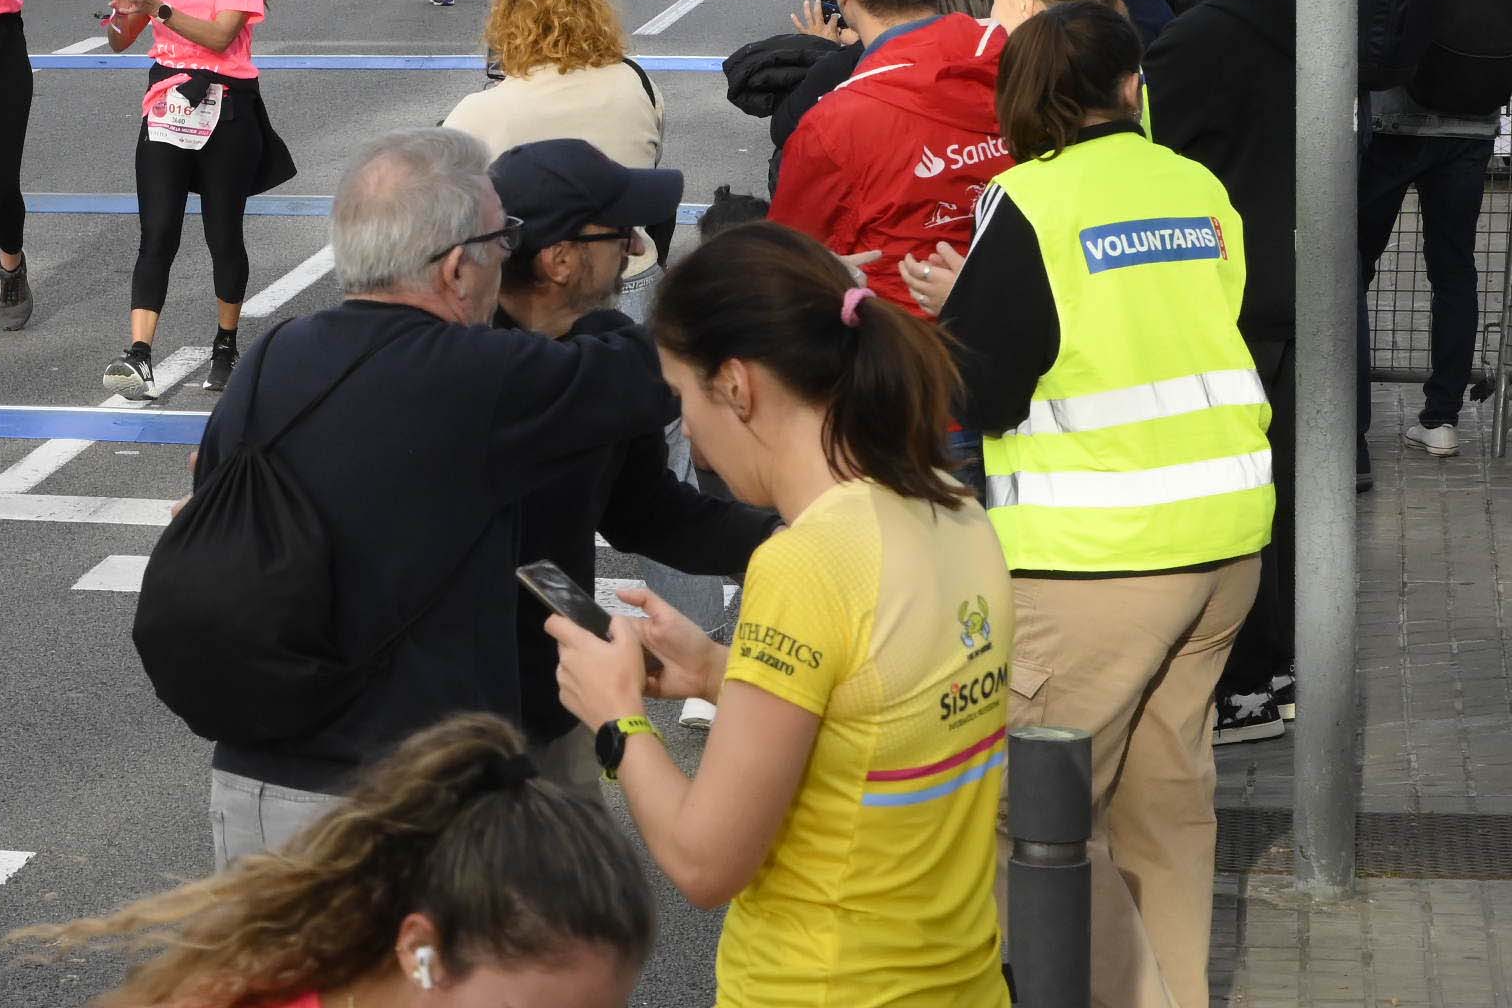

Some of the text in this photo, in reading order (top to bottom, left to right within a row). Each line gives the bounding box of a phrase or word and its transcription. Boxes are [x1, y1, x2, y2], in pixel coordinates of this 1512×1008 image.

[169, 103, 193, 116] 016
[946, 136, 1009, 170] Santa
[1086, 228, 1216, 260] VOLUNTARIS
[753, 650, 795, 676] azaro
